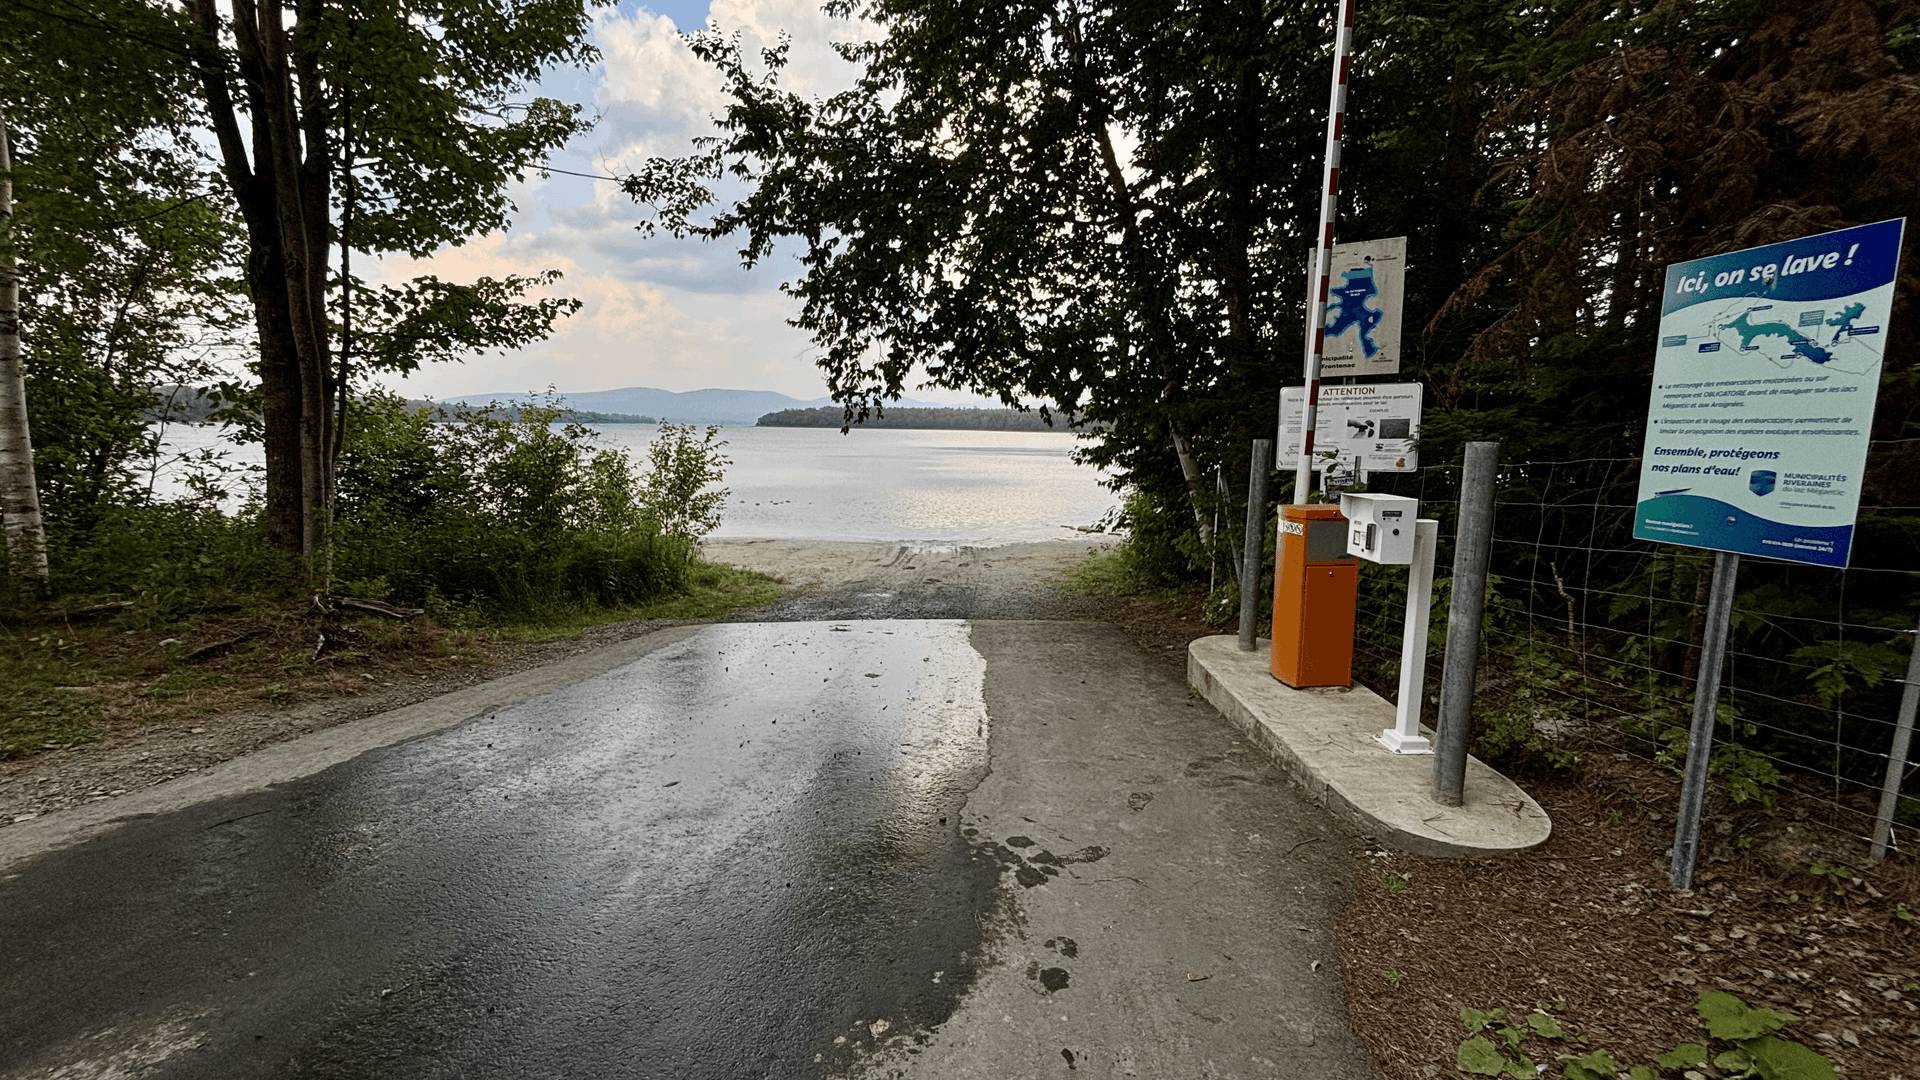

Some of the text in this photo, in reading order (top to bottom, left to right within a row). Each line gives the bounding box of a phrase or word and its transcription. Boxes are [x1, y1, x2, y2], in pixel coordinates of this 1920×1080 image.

[1676, 243, 1860, 294] Ici, on se lave !
[1323, 387, 1376, 396] ATTENTION
[1654, 446, 1780, 460] Ensemble, protégeons
[1651, 464, 1670, 472] nos
[1671, 464, 1701, 474] plans
[1784, 473, 1847, 482] MUNICIPALITÉS
[1783, 480, 1832, 488] RIVERAINES
